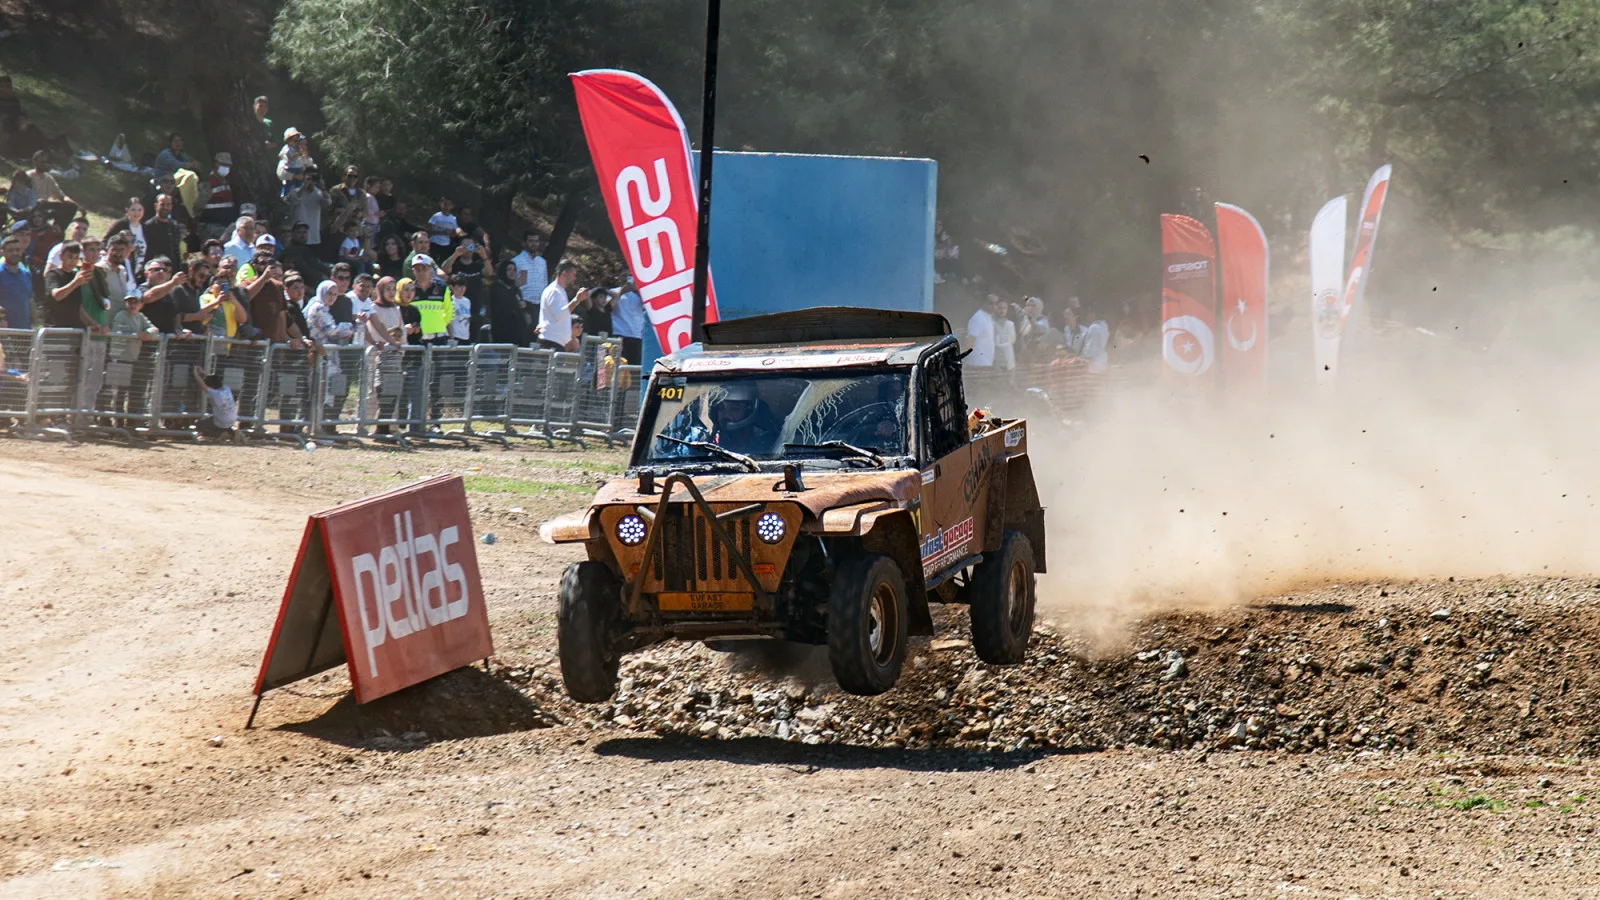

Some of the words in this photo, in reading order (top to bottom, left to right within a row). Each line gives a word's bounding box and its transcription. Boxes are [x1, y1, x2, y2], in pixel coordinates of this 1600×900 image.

[657, 387, 684, 399] 401
[920, 527, 944, 559] ufast
[943, 516, 973, 552] garage
[352, 510, 469, 679] petlas
